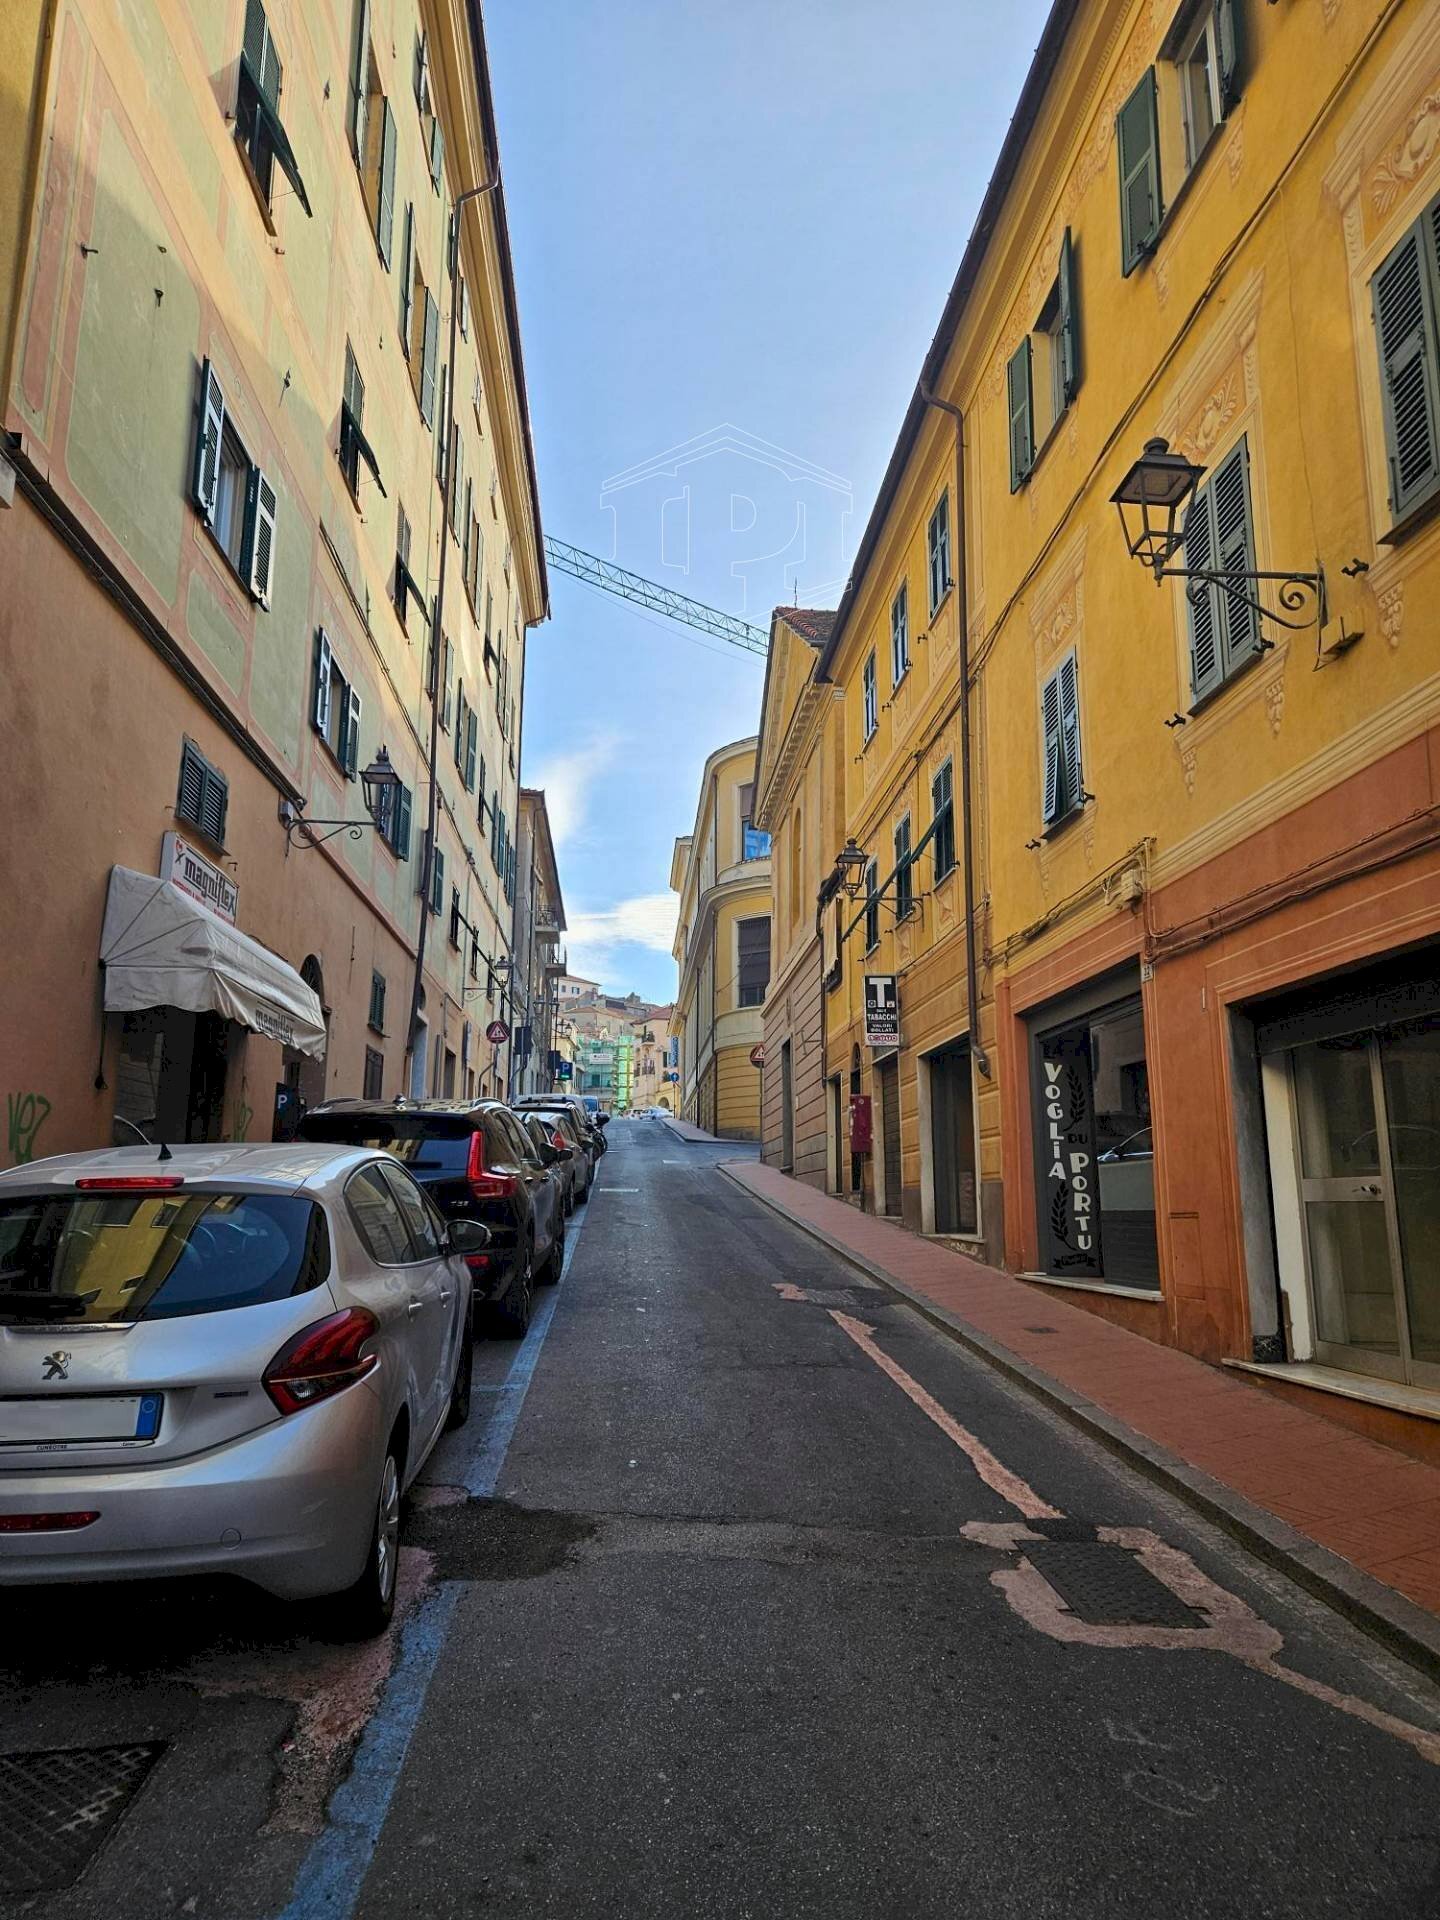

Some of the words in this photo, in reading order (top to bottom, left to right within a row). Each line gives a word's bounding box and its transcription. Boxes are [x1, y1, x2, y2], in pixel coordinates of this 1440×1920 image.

[184, 857, 236, 917] magniflex
[869, 977, 892, 1008] T
[867, 1013, 897, 1021] TABACCHI
[277, 1094, 288, 1109] P
[1069, 1152, 1092, 1251] PORTU
